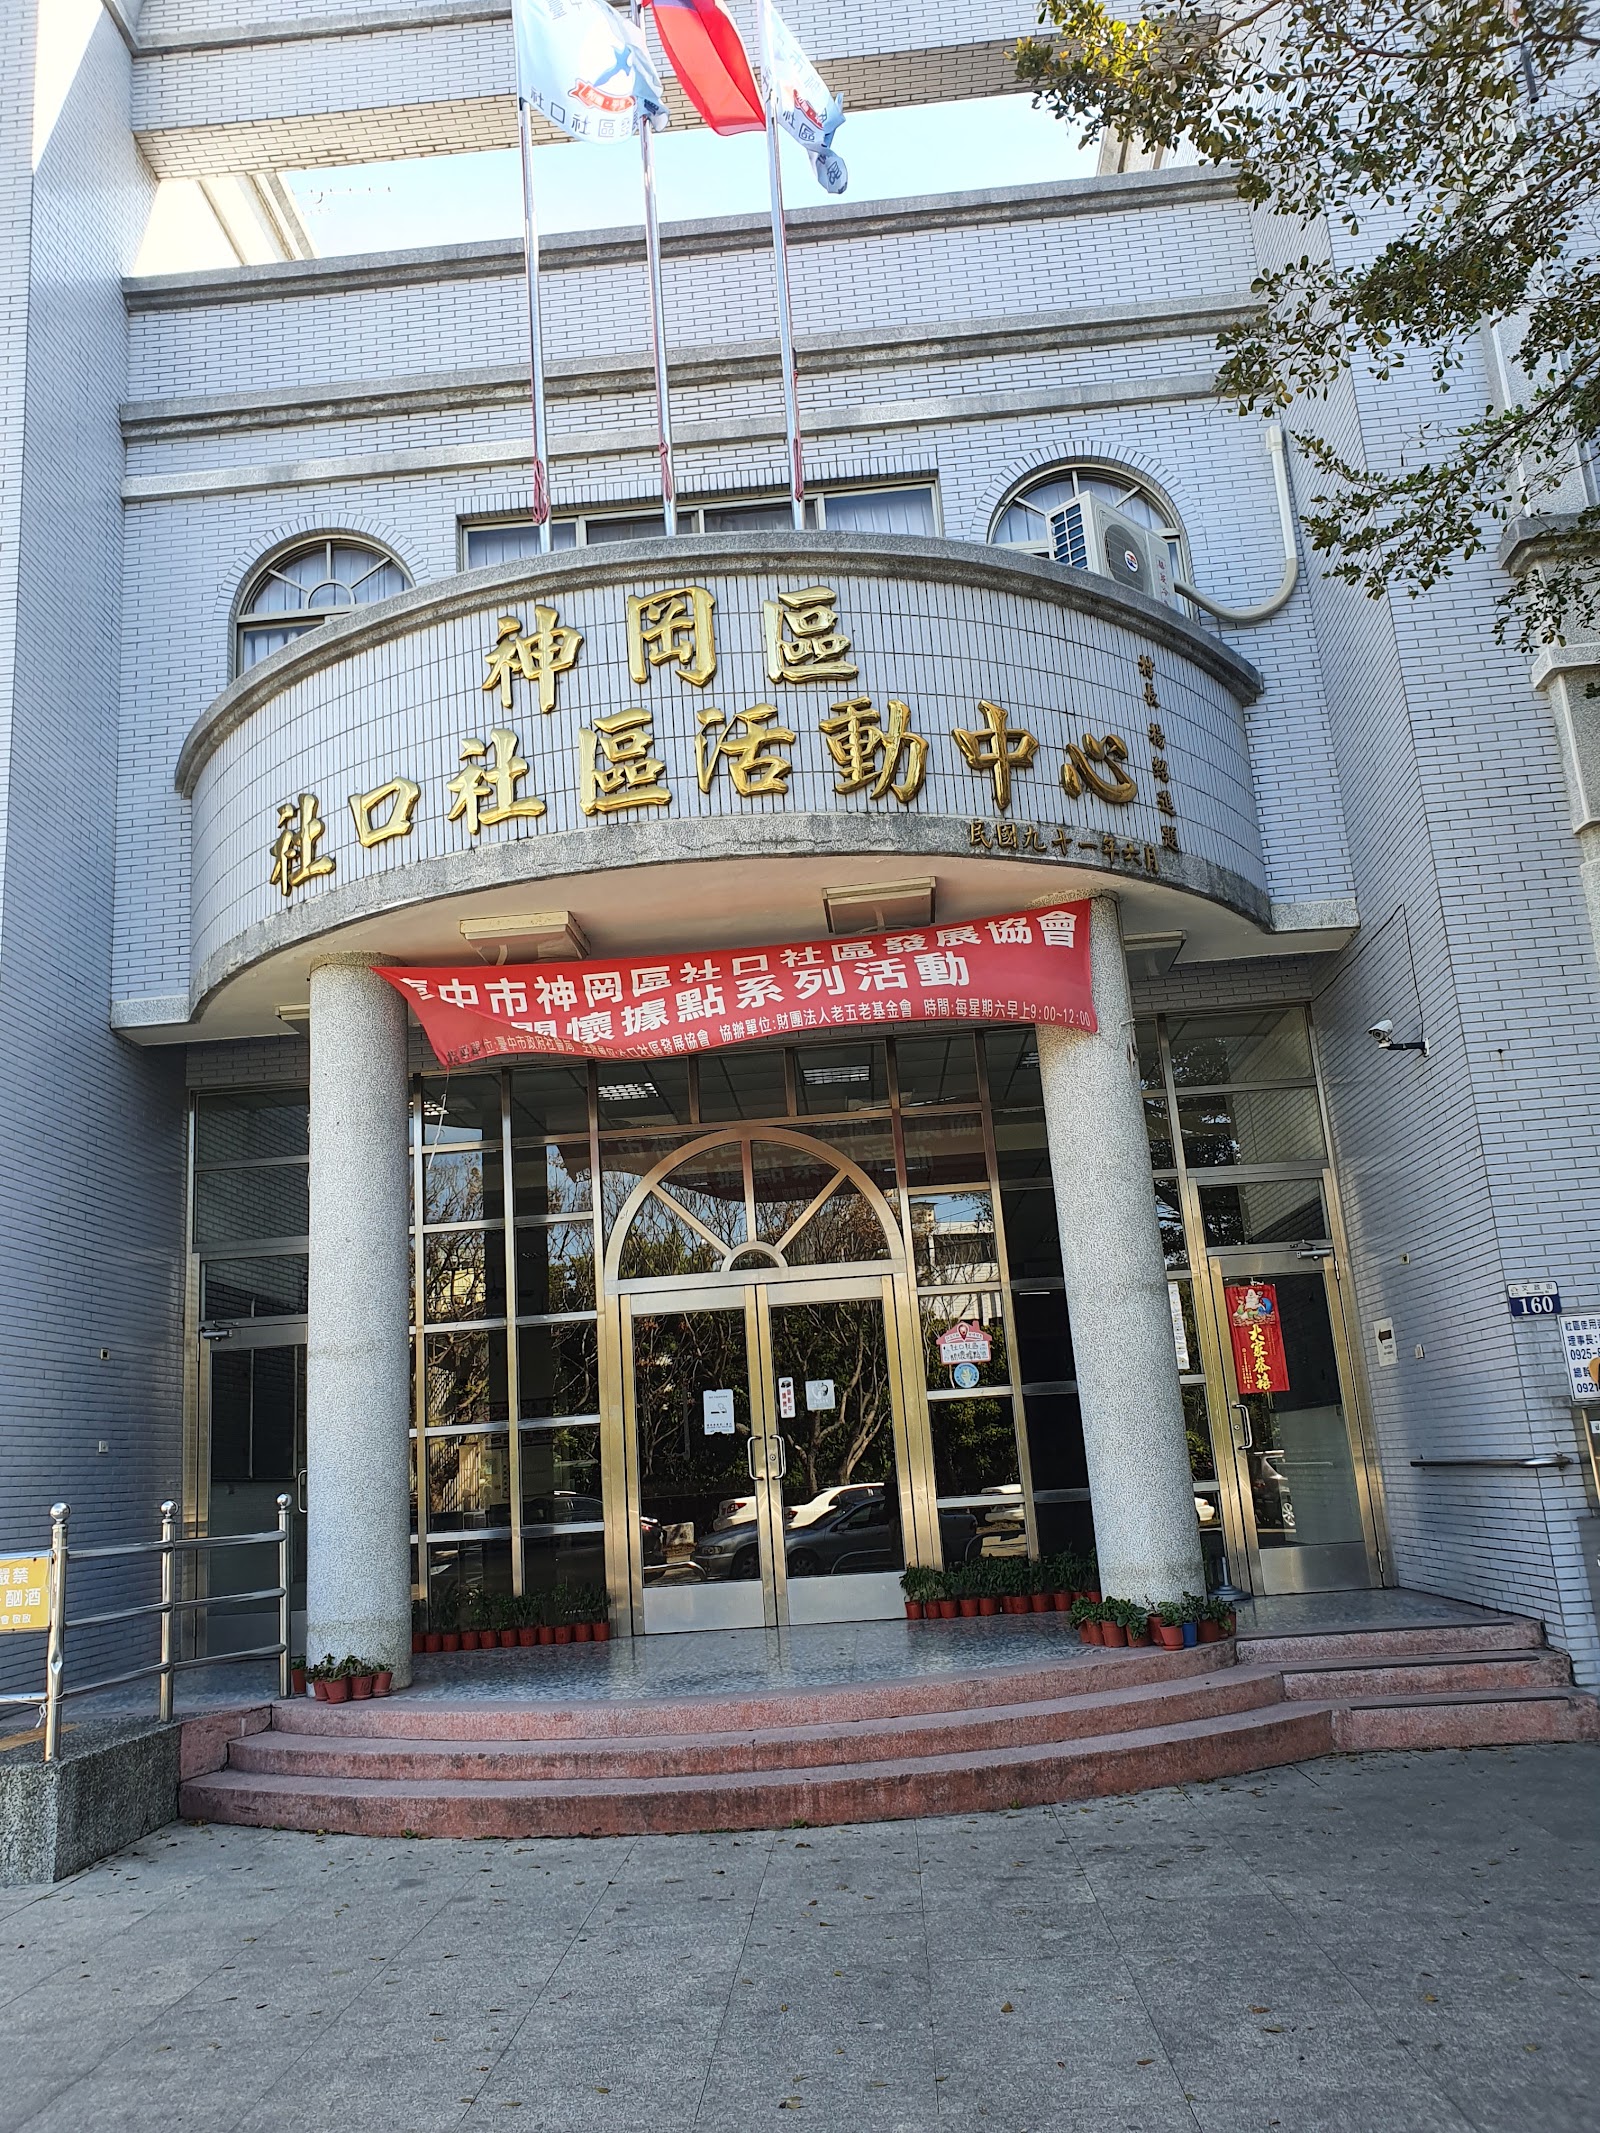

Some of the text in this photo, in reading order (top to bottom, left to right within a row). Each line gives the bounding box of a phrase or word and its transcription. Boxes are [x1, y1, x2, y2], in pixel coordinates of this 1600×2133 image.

[482, 585, 859, 714] 神岡區
[270, 695, 1138, 896] 社口社區活動中心
[969, 819, 1159, 875] 民國九十一年六月
[1519, 1296, 1554, 1314] 160
[1567, 1334, 1600, 1346] 理事長:
